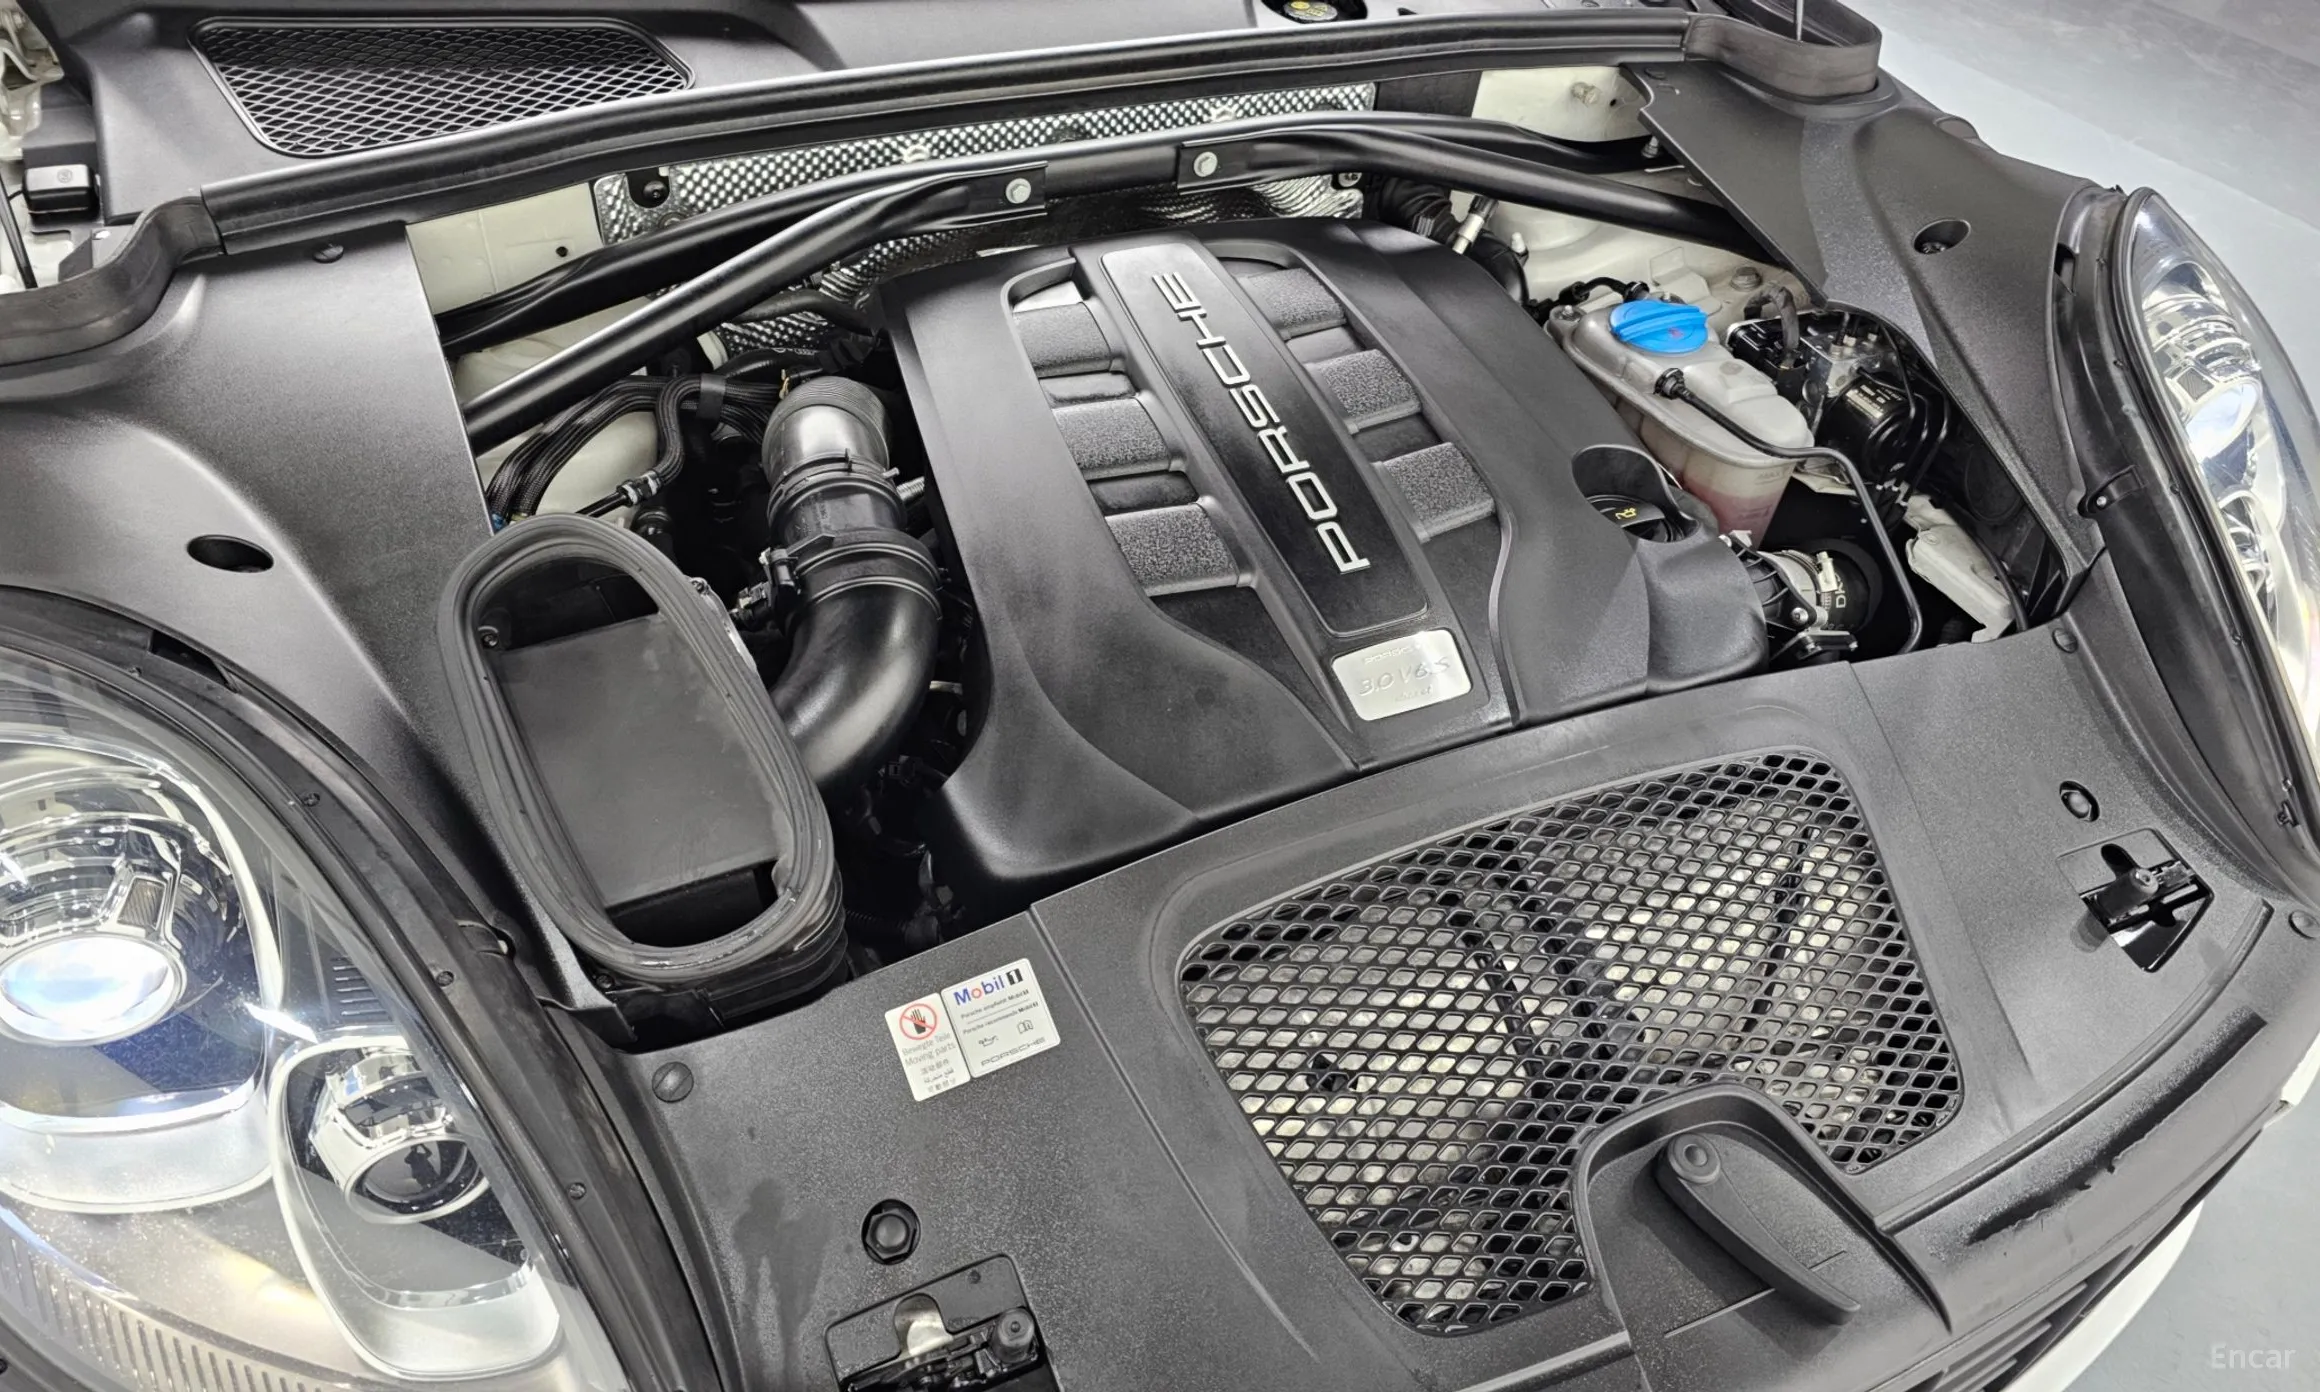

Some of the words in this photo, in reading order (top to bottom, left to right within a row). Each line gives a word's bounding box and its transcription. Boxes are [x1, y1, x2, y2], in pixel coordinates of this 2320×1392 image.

[1152, 272, 1371, 574] PORSCHE
[1359, 672, 1395, 697] 3.0
[1399, 662, 1429, 684] V6
[953, 975, 1005, 1006] Mobil
[1007, 969, 1022, 985] 1
[904, 1050, 935, 1067] Moving
[935, 1042, 957, 1056] parts
